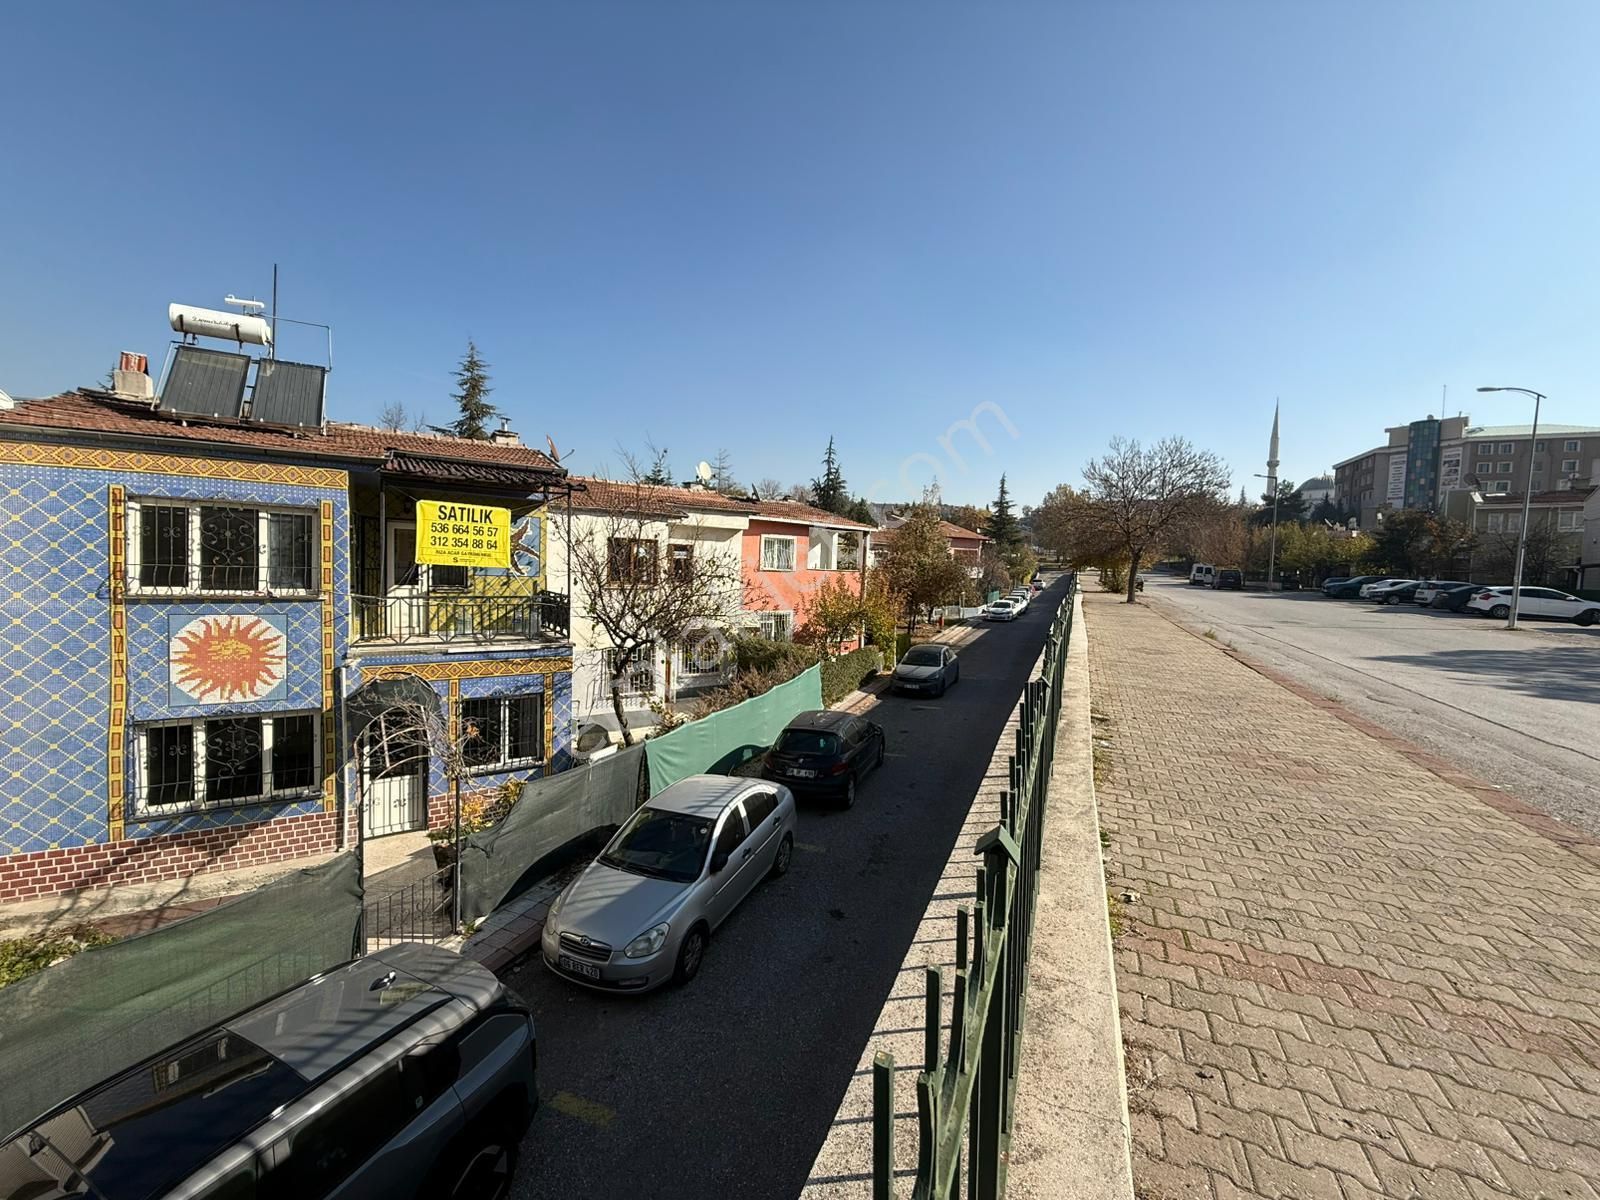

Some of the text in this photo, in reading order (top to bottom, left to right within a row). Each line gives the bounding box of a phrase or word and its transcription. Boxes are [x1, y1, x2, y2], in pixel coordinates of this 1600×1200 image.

[438, 505, 493, 524] SATILIK
[431, 522, 498, 537] 536 664 56 57
[430, 536, 498, 550] 312 354 88 64
